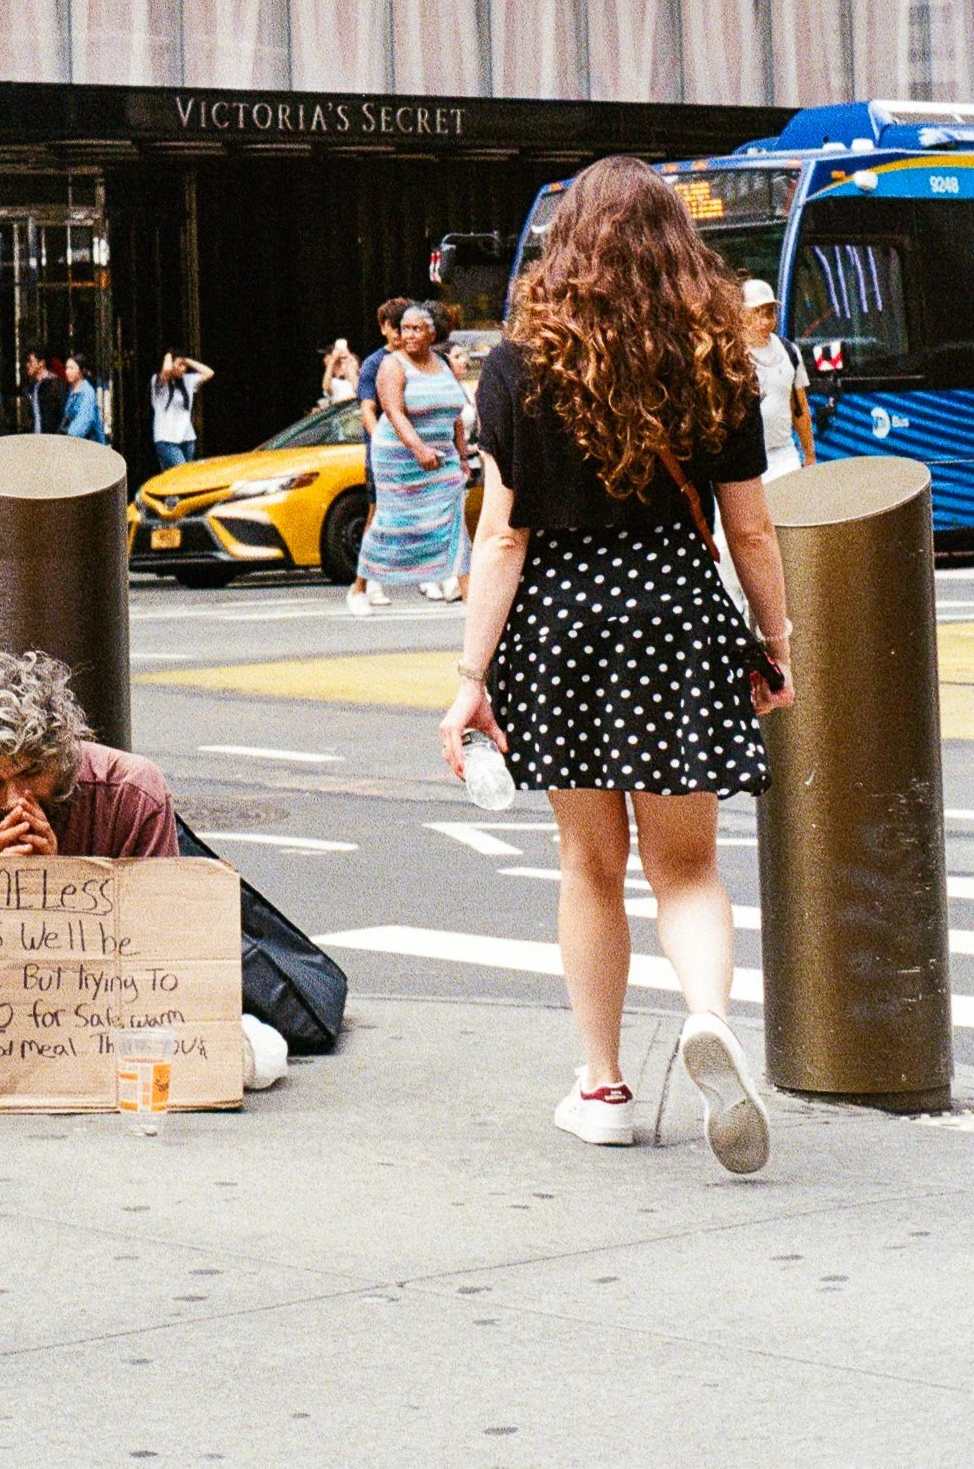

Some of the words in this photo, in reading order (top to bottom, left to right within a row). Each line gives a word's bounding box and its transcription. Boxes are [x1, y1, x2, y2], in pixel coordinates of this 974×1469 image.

[177, 96, 350, 132] VICTORIA'S
[362, 102, 466, 134] SECRET
[100, 921, 141, 956] be
[28, 999, 66, 1029] for
